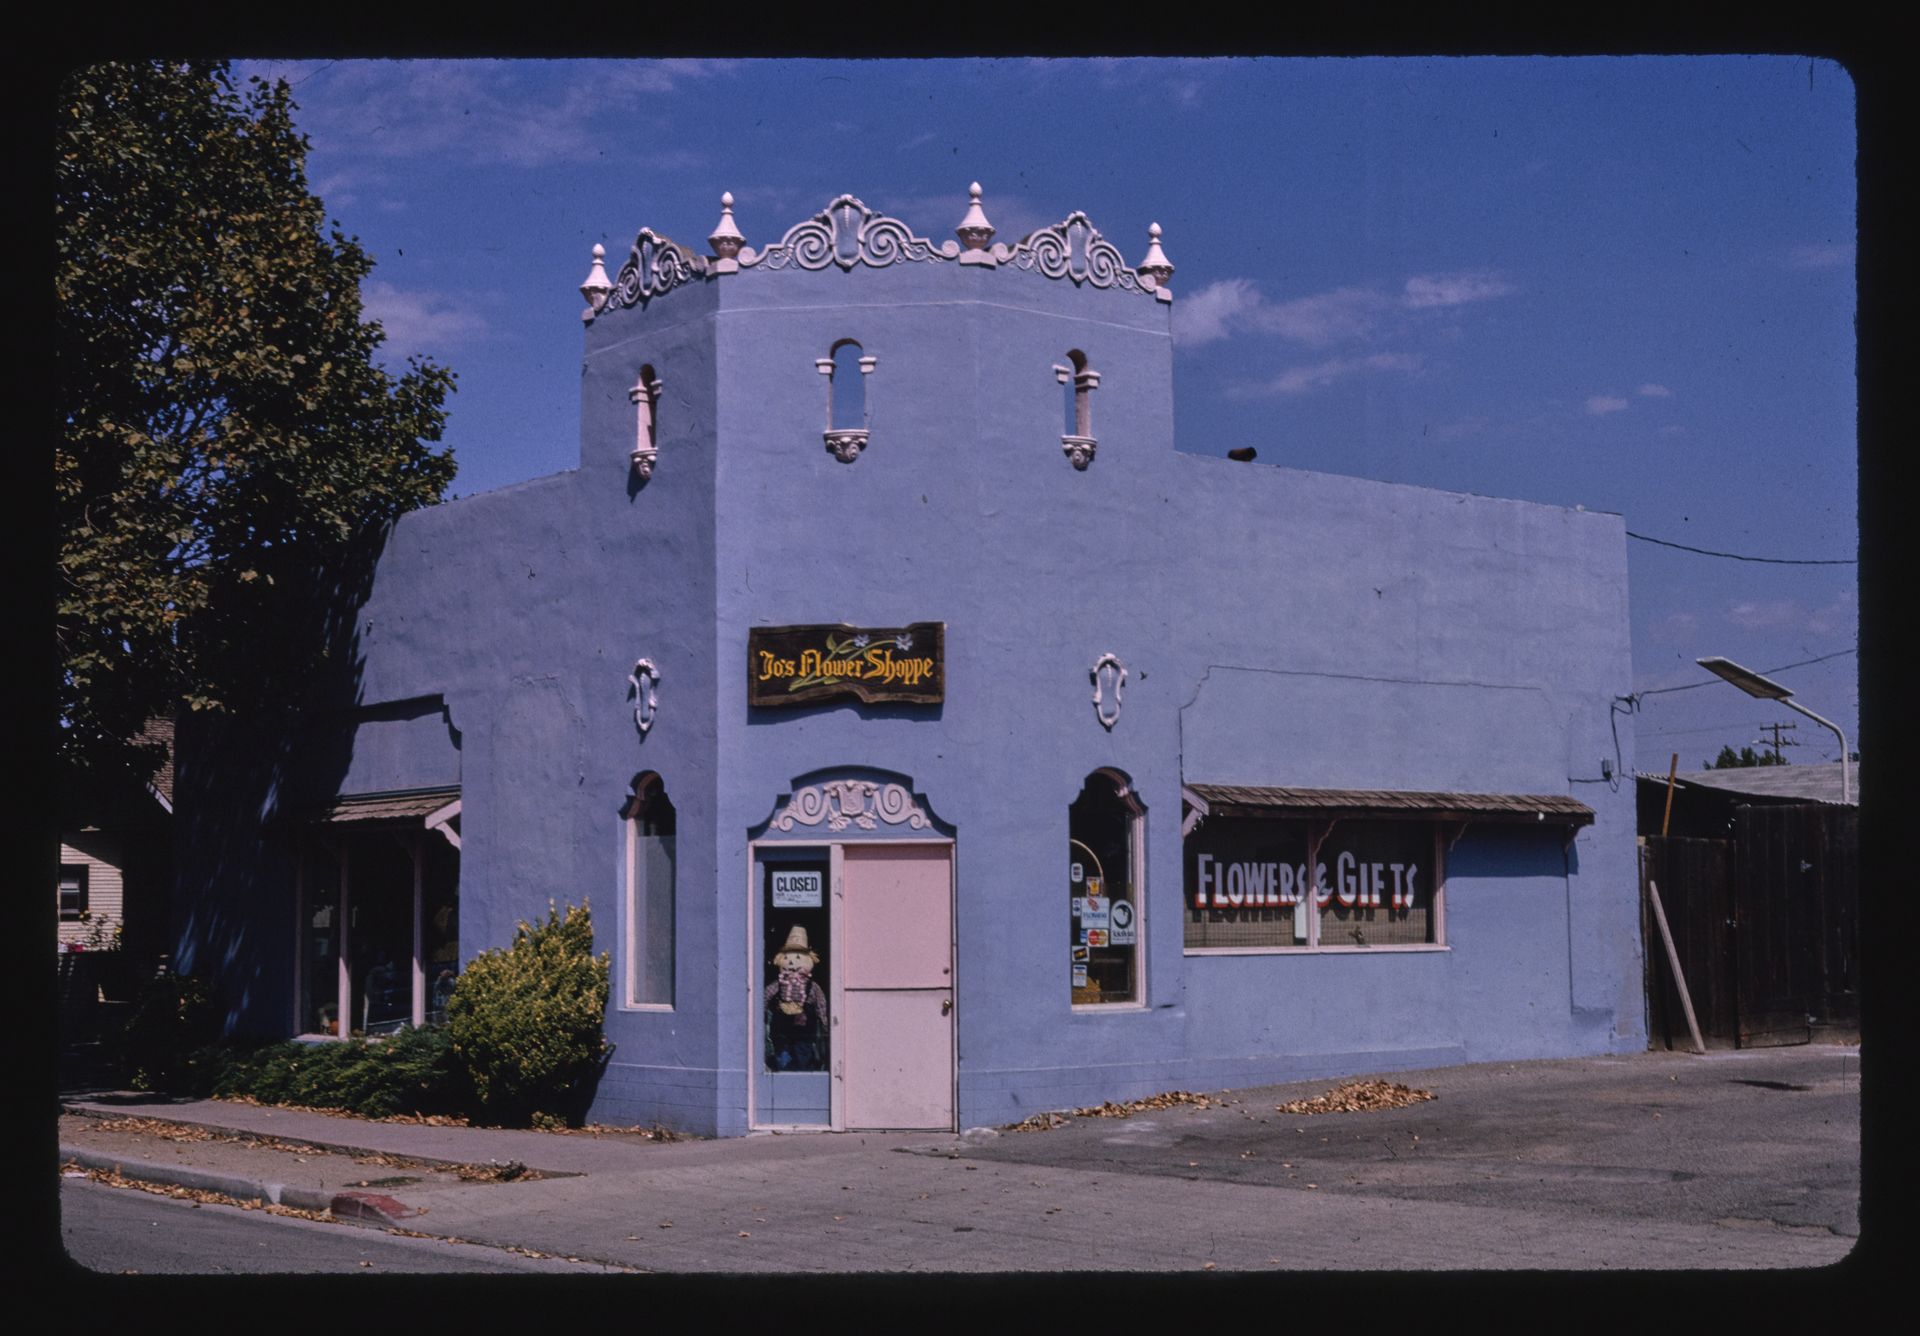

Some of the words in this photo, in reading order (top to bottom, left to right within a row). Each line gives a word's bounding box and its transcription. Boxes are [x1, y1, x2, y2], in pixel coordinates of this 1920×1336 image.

[798, 648, 864, 678] Flower
[862, 648, 934, 685] Shoppe
[776, 876, 818, 892] CLOSED
[1195, 853, 1307, 907] FLOWERS
[1336, 851, 1418, 907] GIFTS
